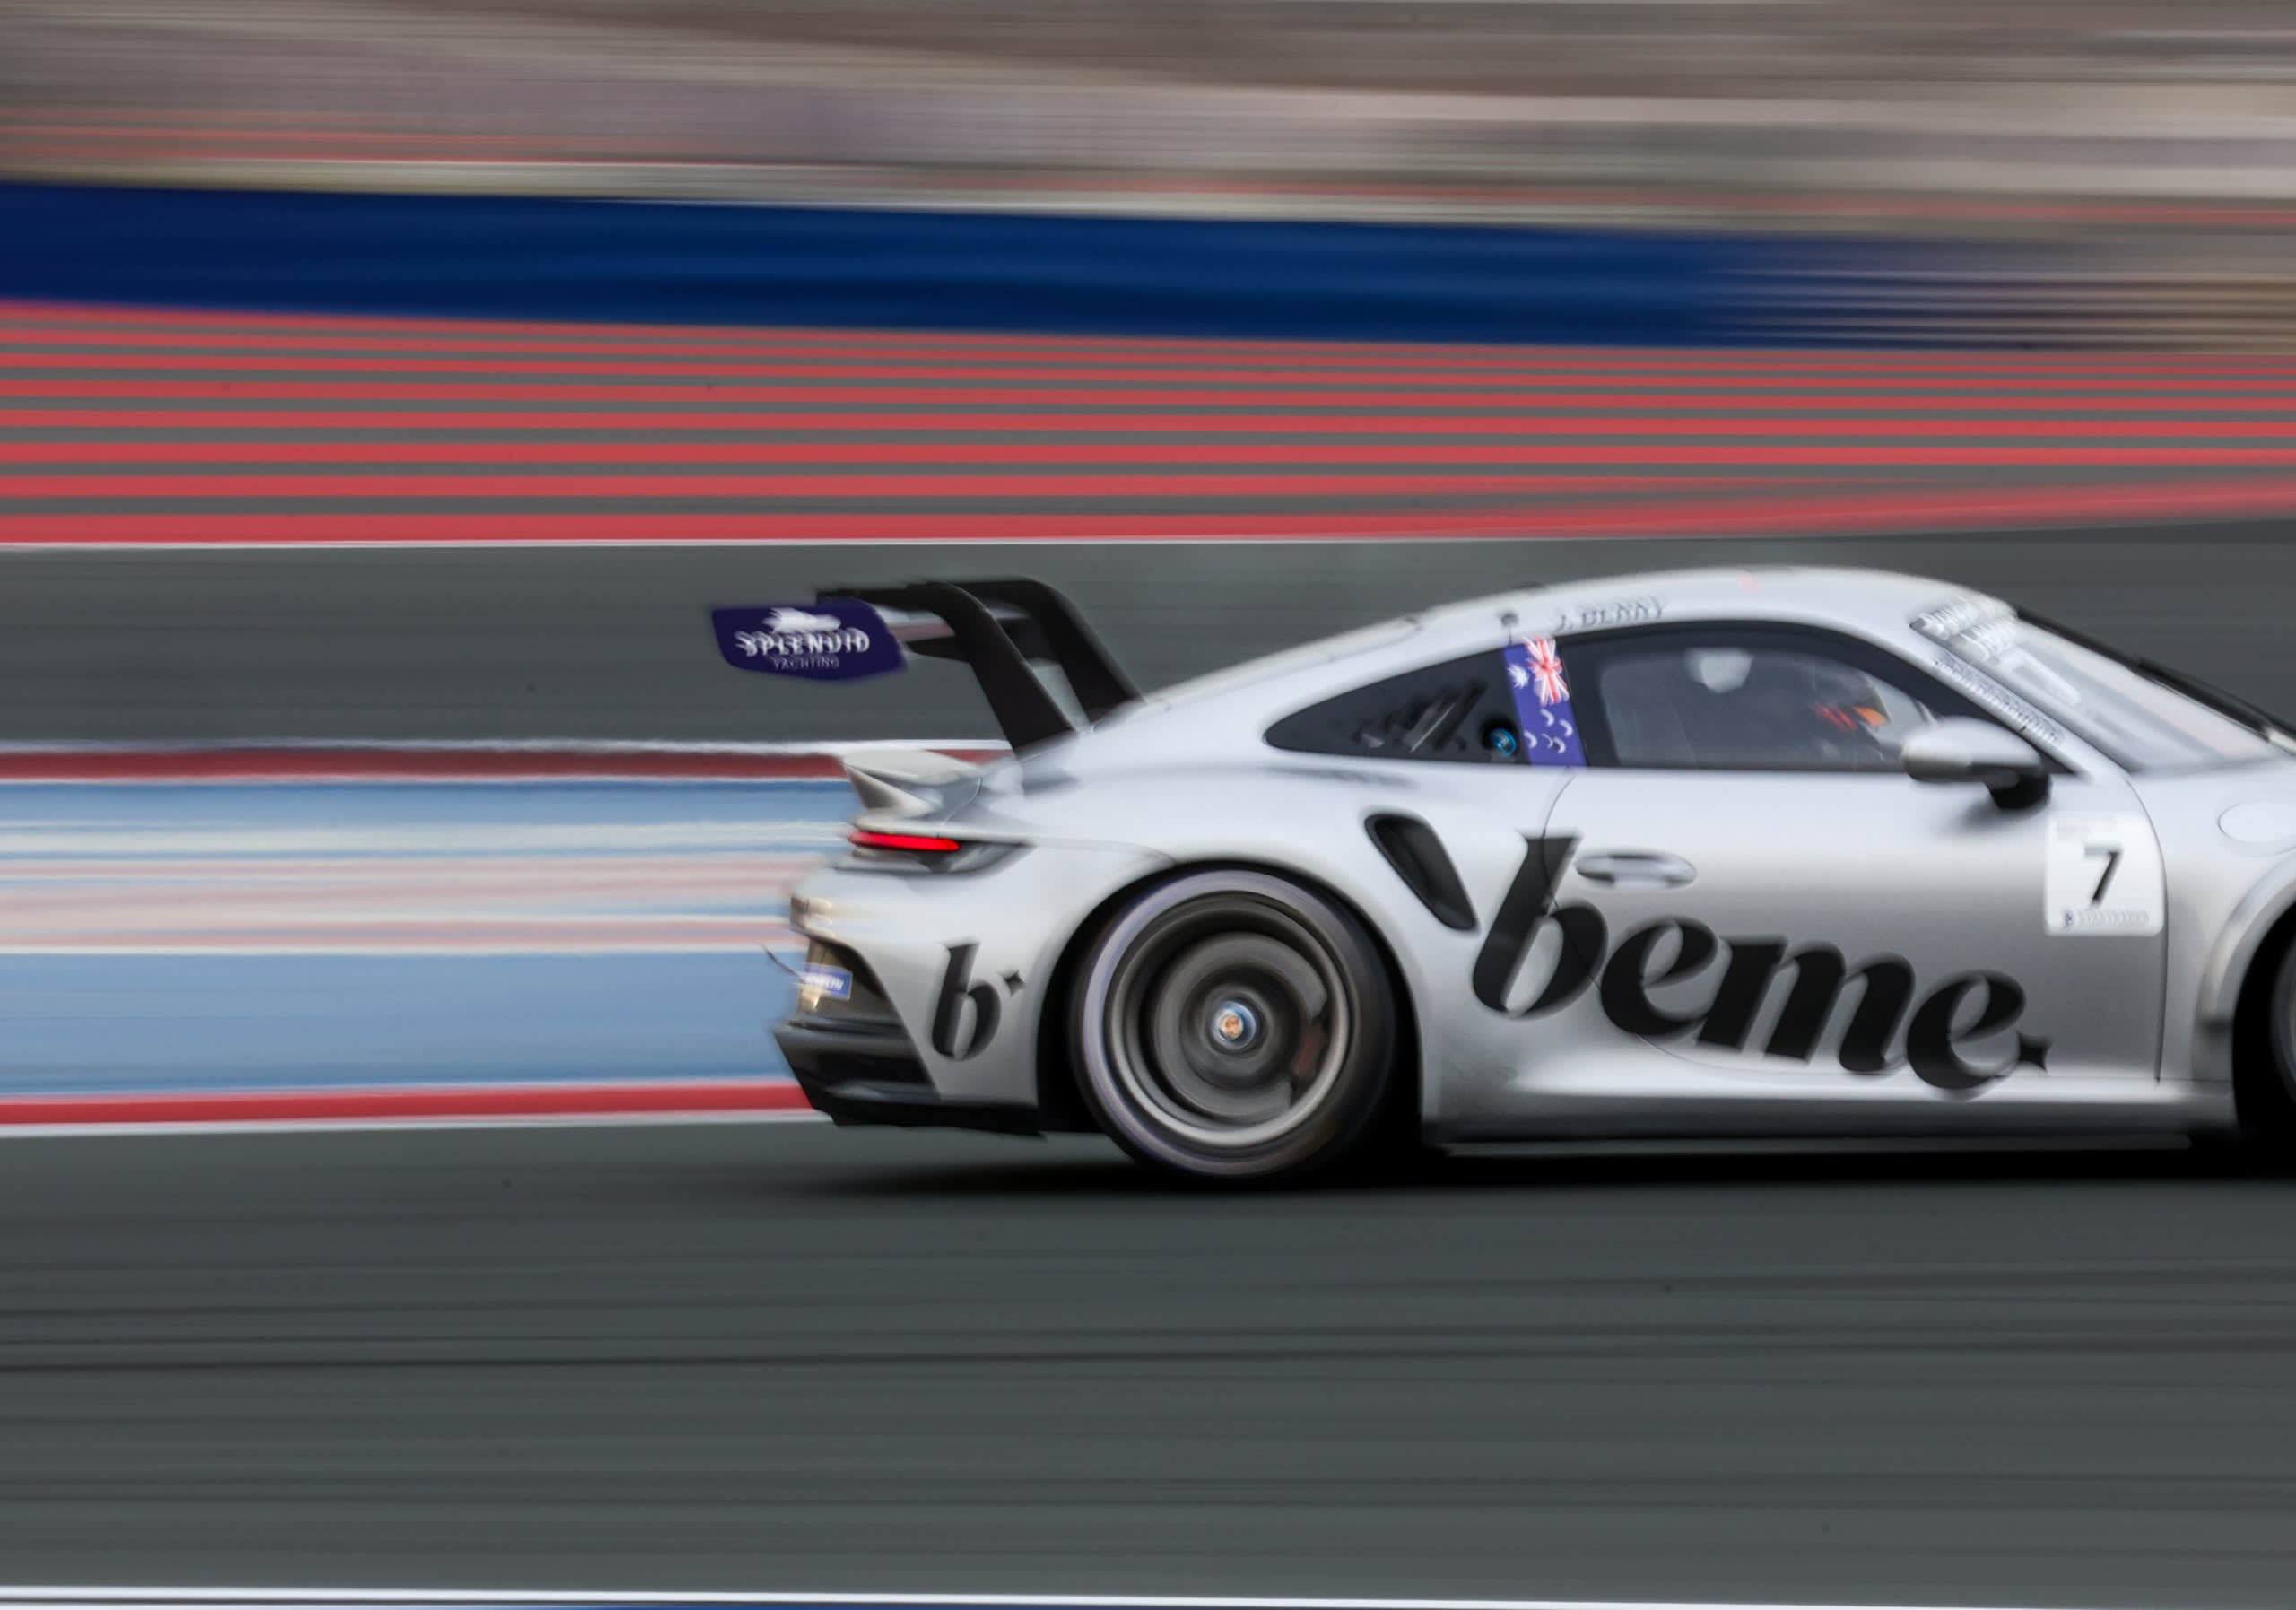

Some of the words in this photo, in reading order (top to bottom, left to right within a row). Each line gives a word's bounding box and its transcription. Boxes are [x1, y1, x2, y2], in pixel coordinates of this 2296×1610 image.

[734, 627, 870, 657] SPLENDID
[2083, 840, 2125, 908] 7
[932, 940, 1001, 1061] b
